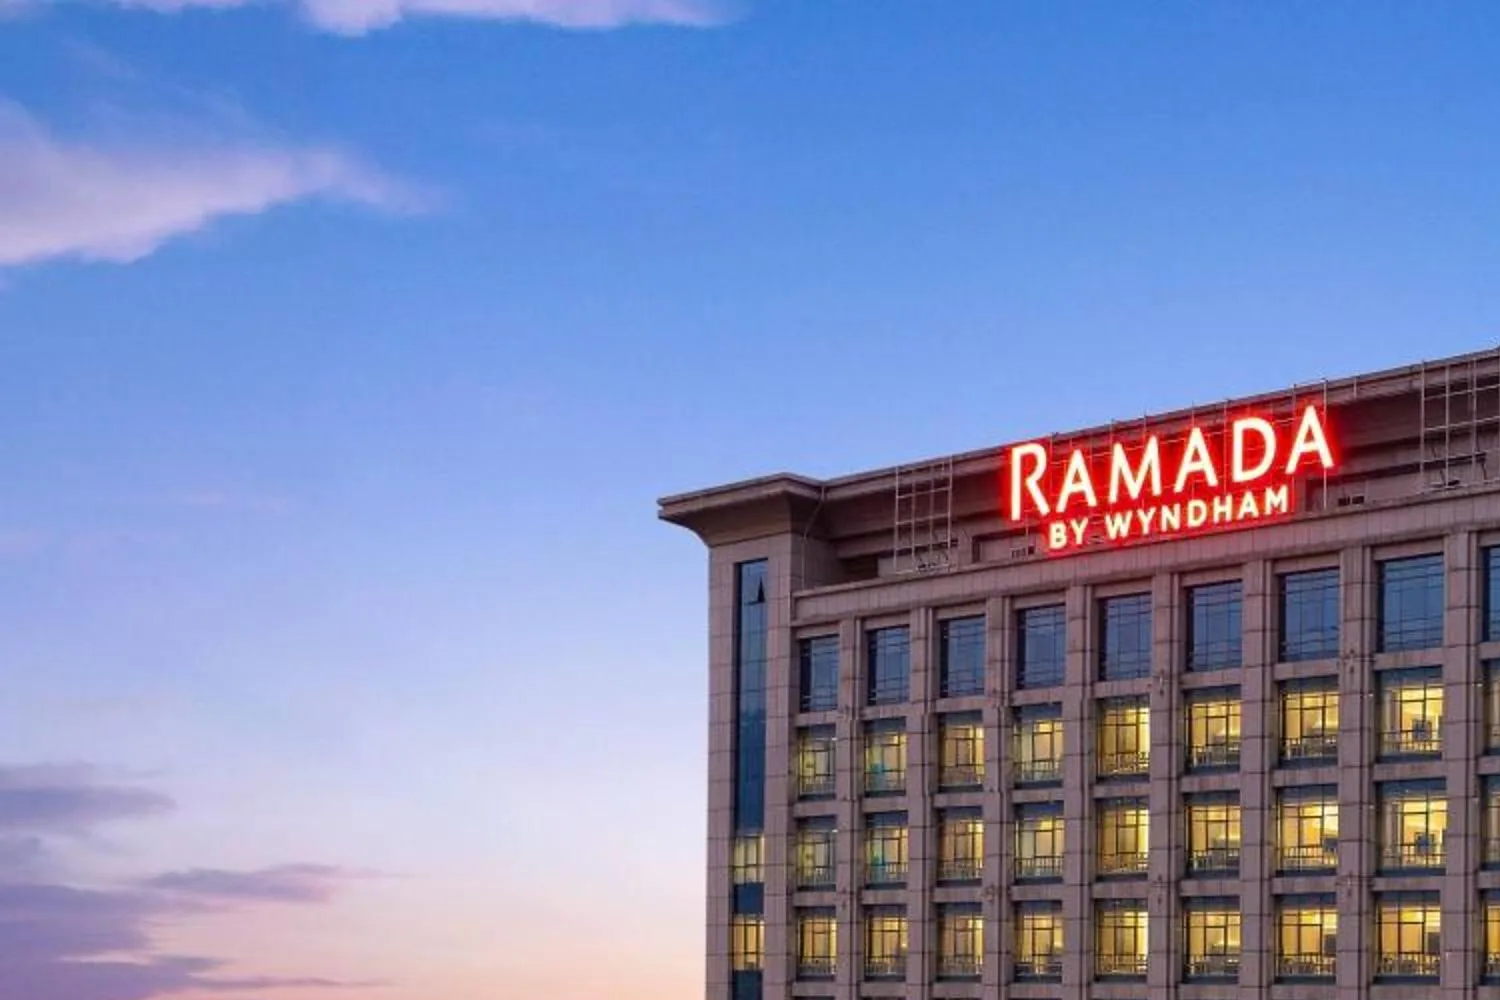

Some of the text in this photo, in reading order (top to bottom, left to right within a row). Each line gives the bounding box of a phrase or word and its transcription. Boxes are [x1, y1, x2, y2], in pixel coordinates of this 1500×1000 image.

[1010, 405, 1335, 521] RAMADA
[1049, 485, 1289, 549] BY WYNDHAM
